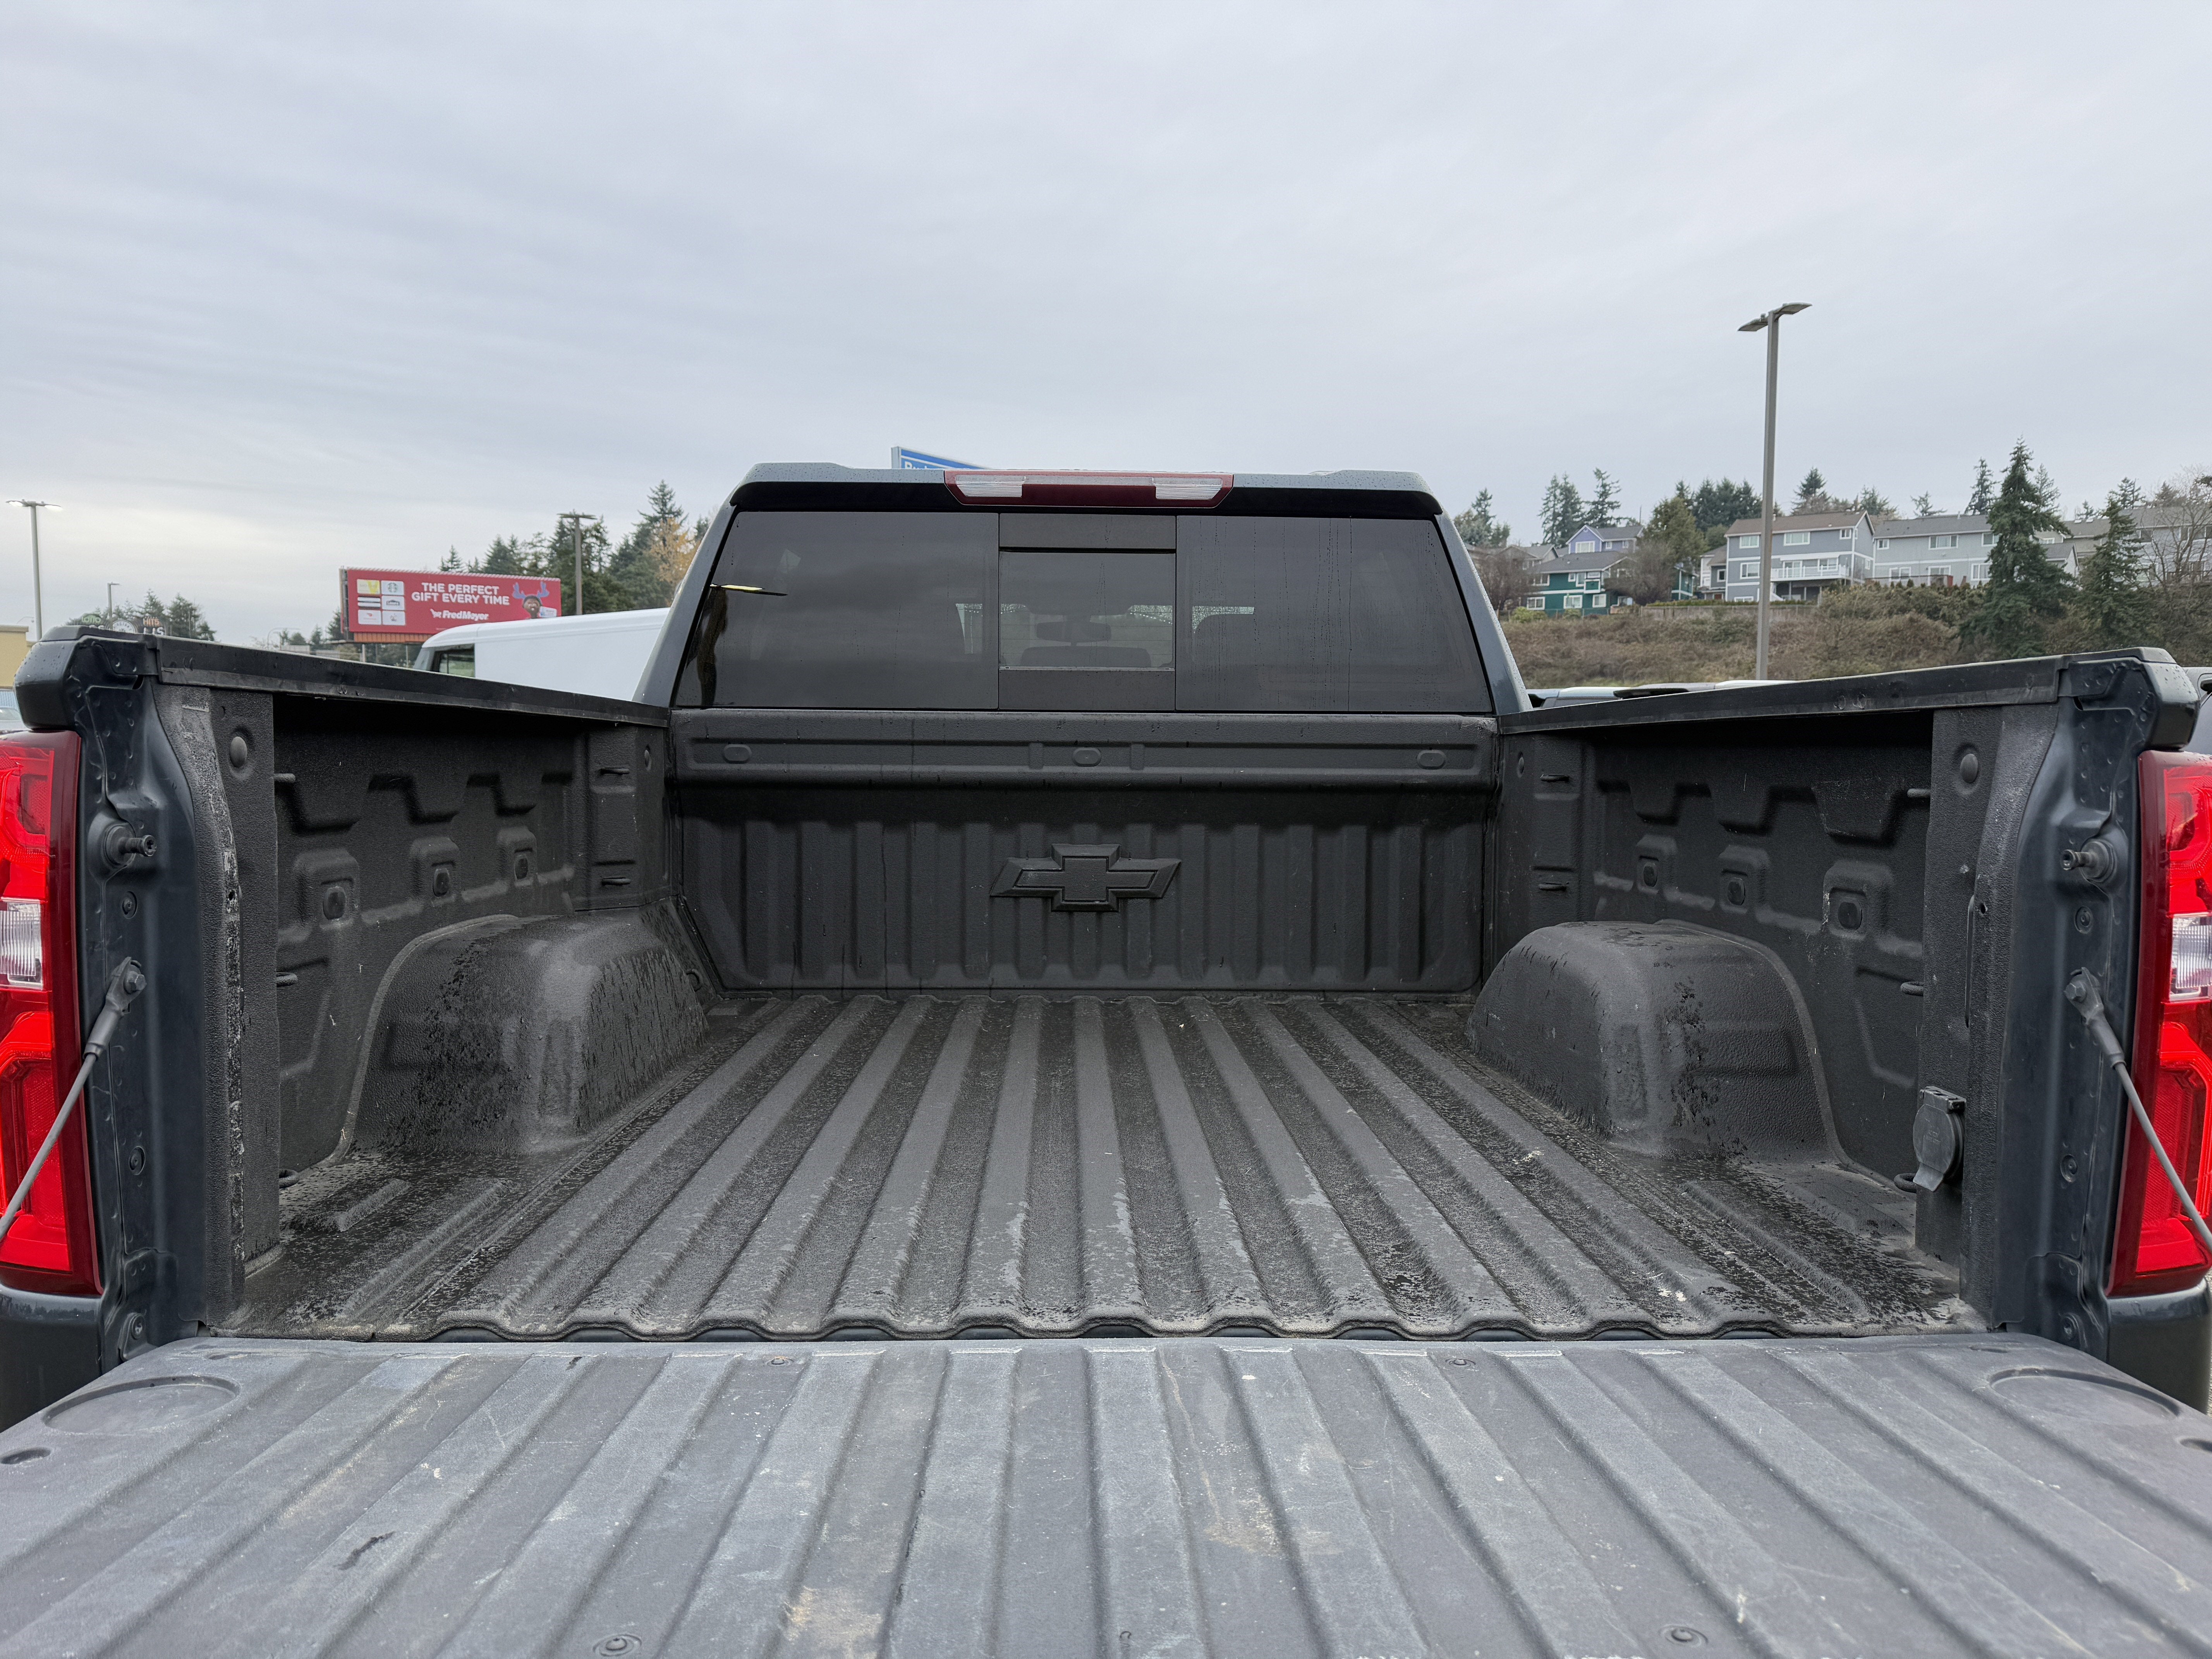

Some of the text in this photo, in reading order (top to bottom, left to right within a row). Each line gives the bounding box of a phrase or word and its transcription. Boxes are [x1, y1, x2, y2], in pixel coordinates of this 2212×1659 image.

[422, 582, 499, 595] THE PERFECT
[412, 592, 510, 605] GIFT EVERY TIME
